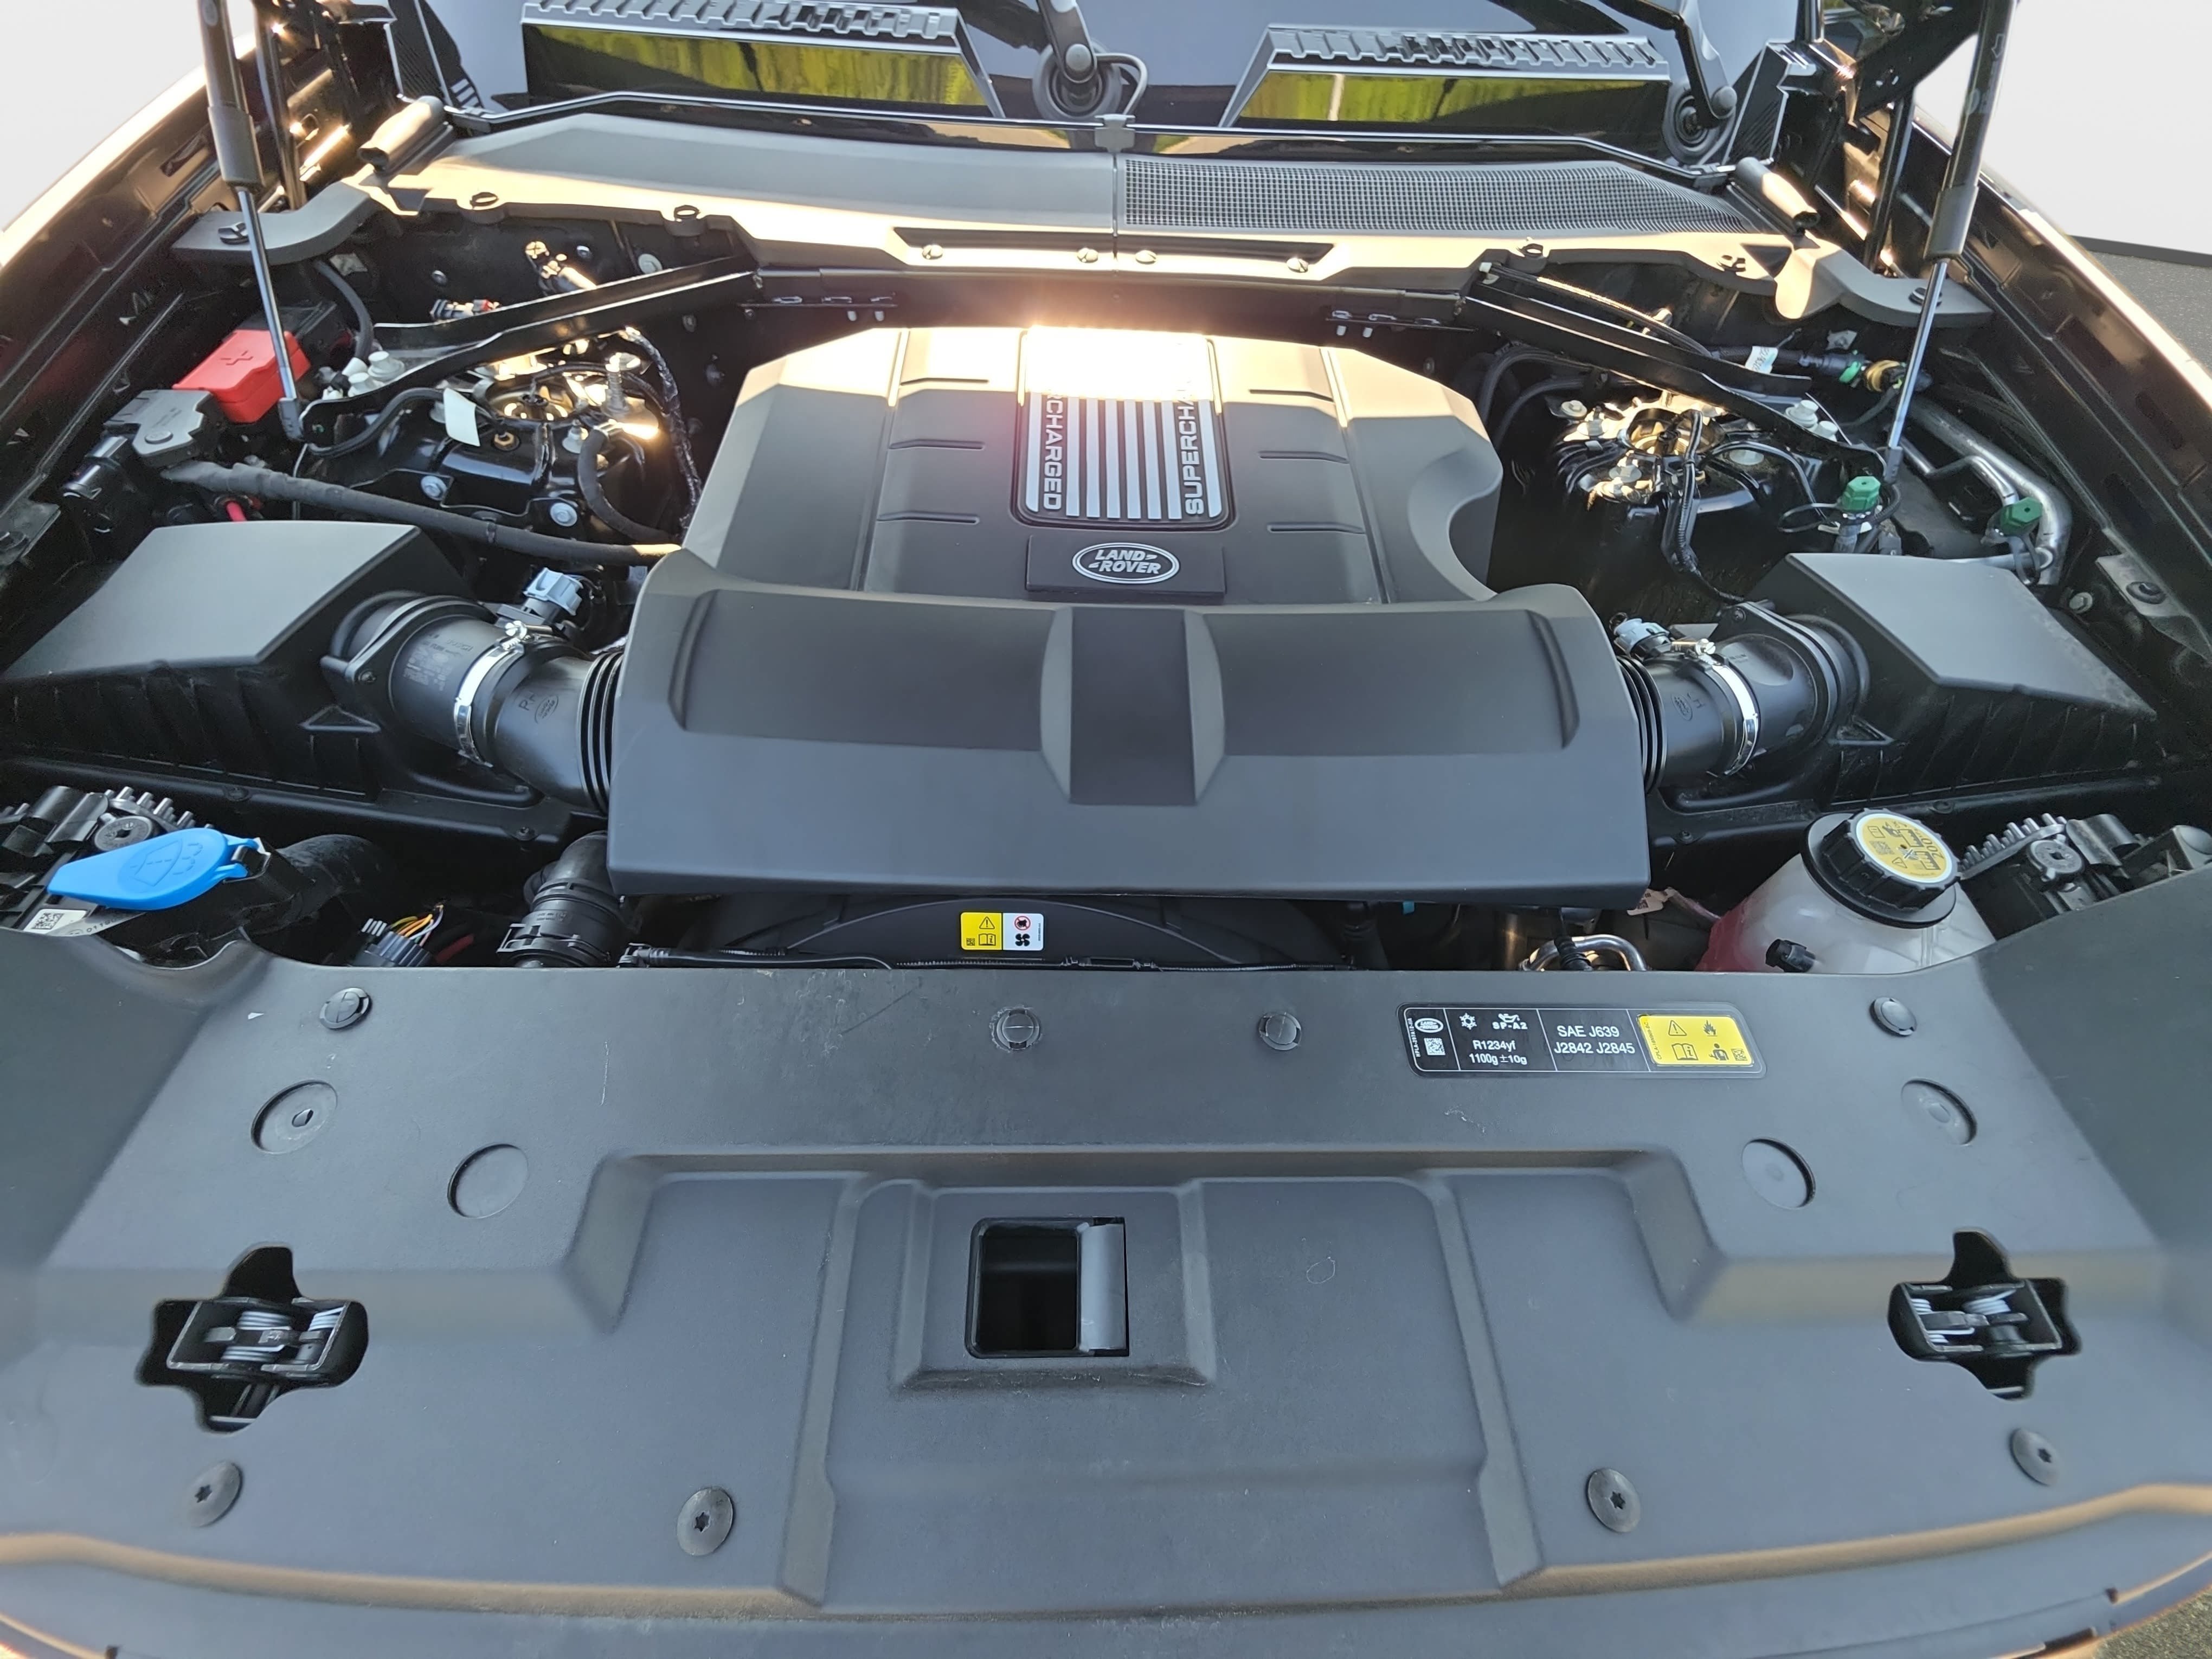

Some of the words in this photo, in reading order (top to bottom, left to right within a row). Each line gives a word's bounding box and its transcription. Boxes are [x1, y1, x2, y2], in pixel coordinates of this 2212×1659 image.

[1095, 549, 1146, 561] LAND
[1098, 560, 1162, 574] ROVER
[1492, 1021, 1528, 1030] SP-A2
[1557, 1025, 1587, 1037] SAE
[1589, 1025, 1620, 1037] J639
[1472, 1039, 1516, 1052] R1234yf
[1554, 1041, 1594, 1054] J2842
[1596, 1041, 1636, 1054] J2845
[1469, 1053, 1499, 1066] 1100g
[1499, 1054, 1528, 1065] ±10g
